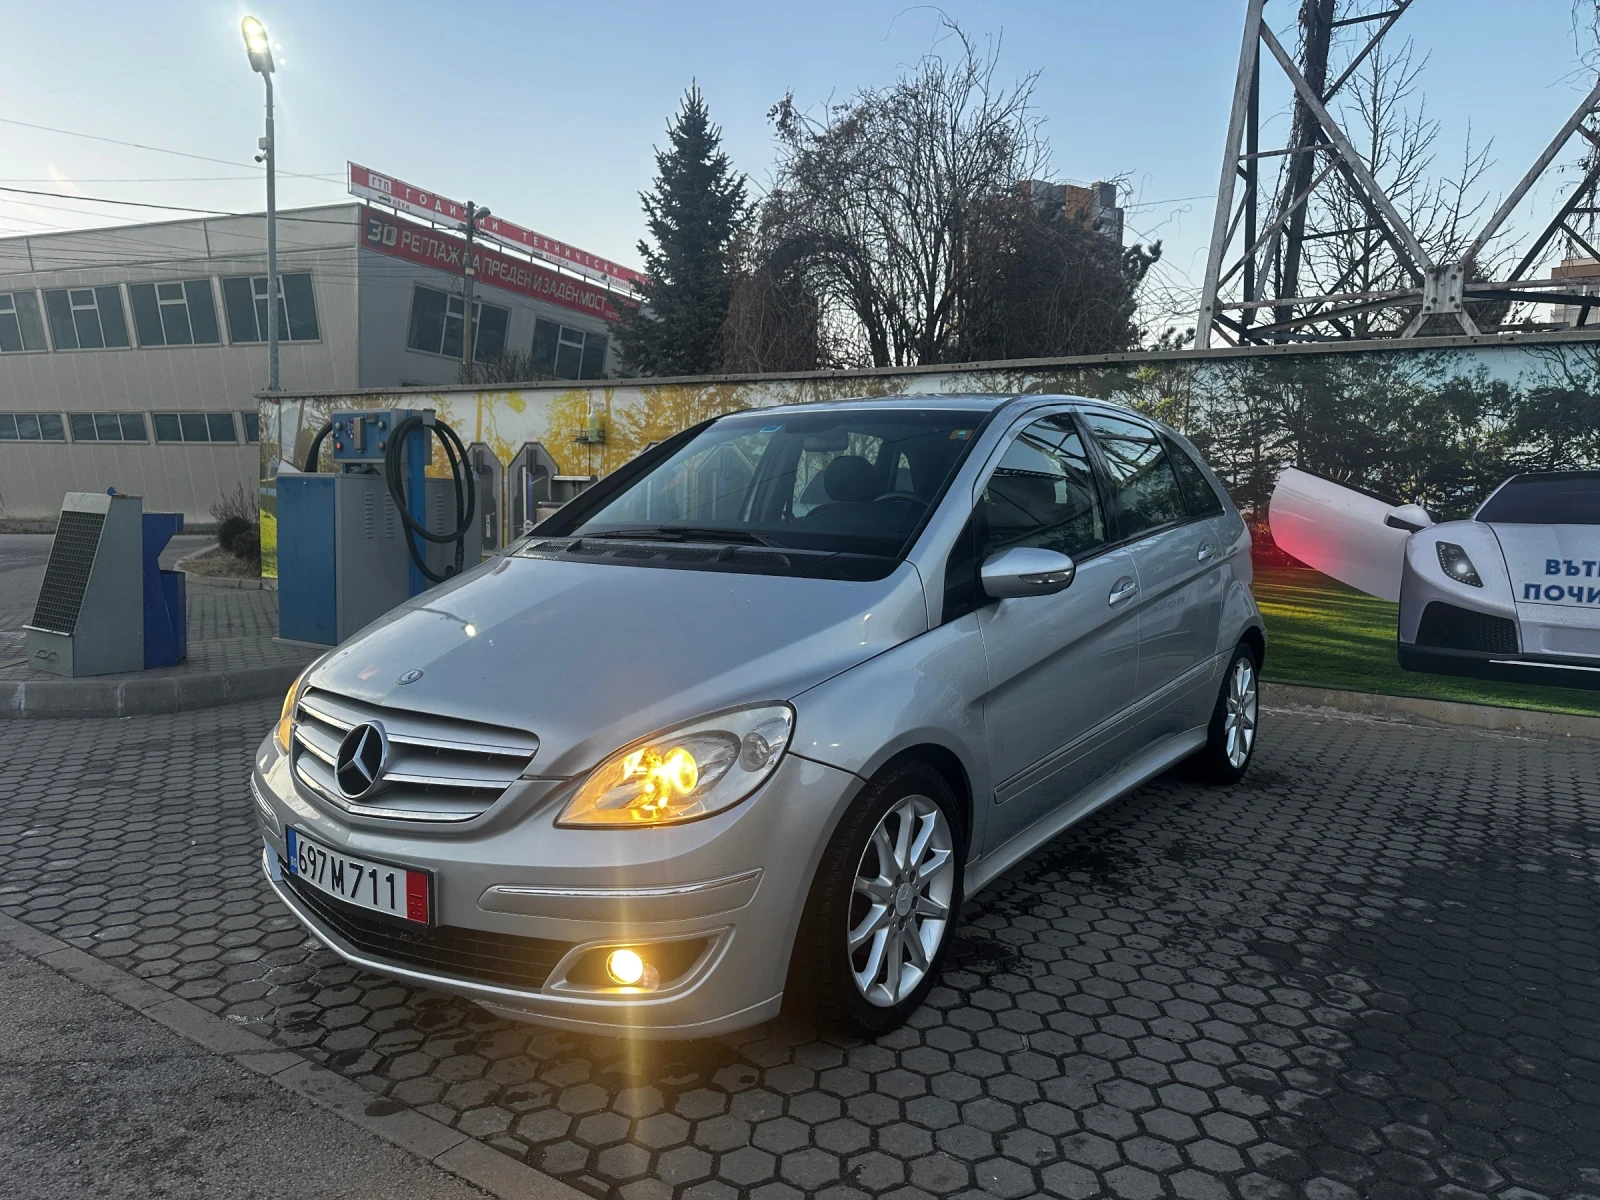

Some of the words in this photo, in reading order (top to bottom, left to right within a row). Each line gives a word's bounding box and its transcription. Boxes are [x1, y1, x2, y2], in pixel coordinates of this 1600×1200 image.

[372, 176, 390, 192] ГТП
[392, 199, 410, 211] ЛЕКИ
[406, 189, 498, 231] ГОДИНИ
[523, 232, 618, 275] ТЕХНИЧЕСКИ
[367, 218, 398, 247] 3D
[401, 229, 460, 267] РЕГЛАЖ
[482, 257, 532, 288] ПРЕДЕН
[534, 274, 542, 291] И
[543, 278, 579, 303] ЗАДЕН
[580, 290, 606, 311] МОСТ
[1545, 558, 1600, 578] ВЪТ
